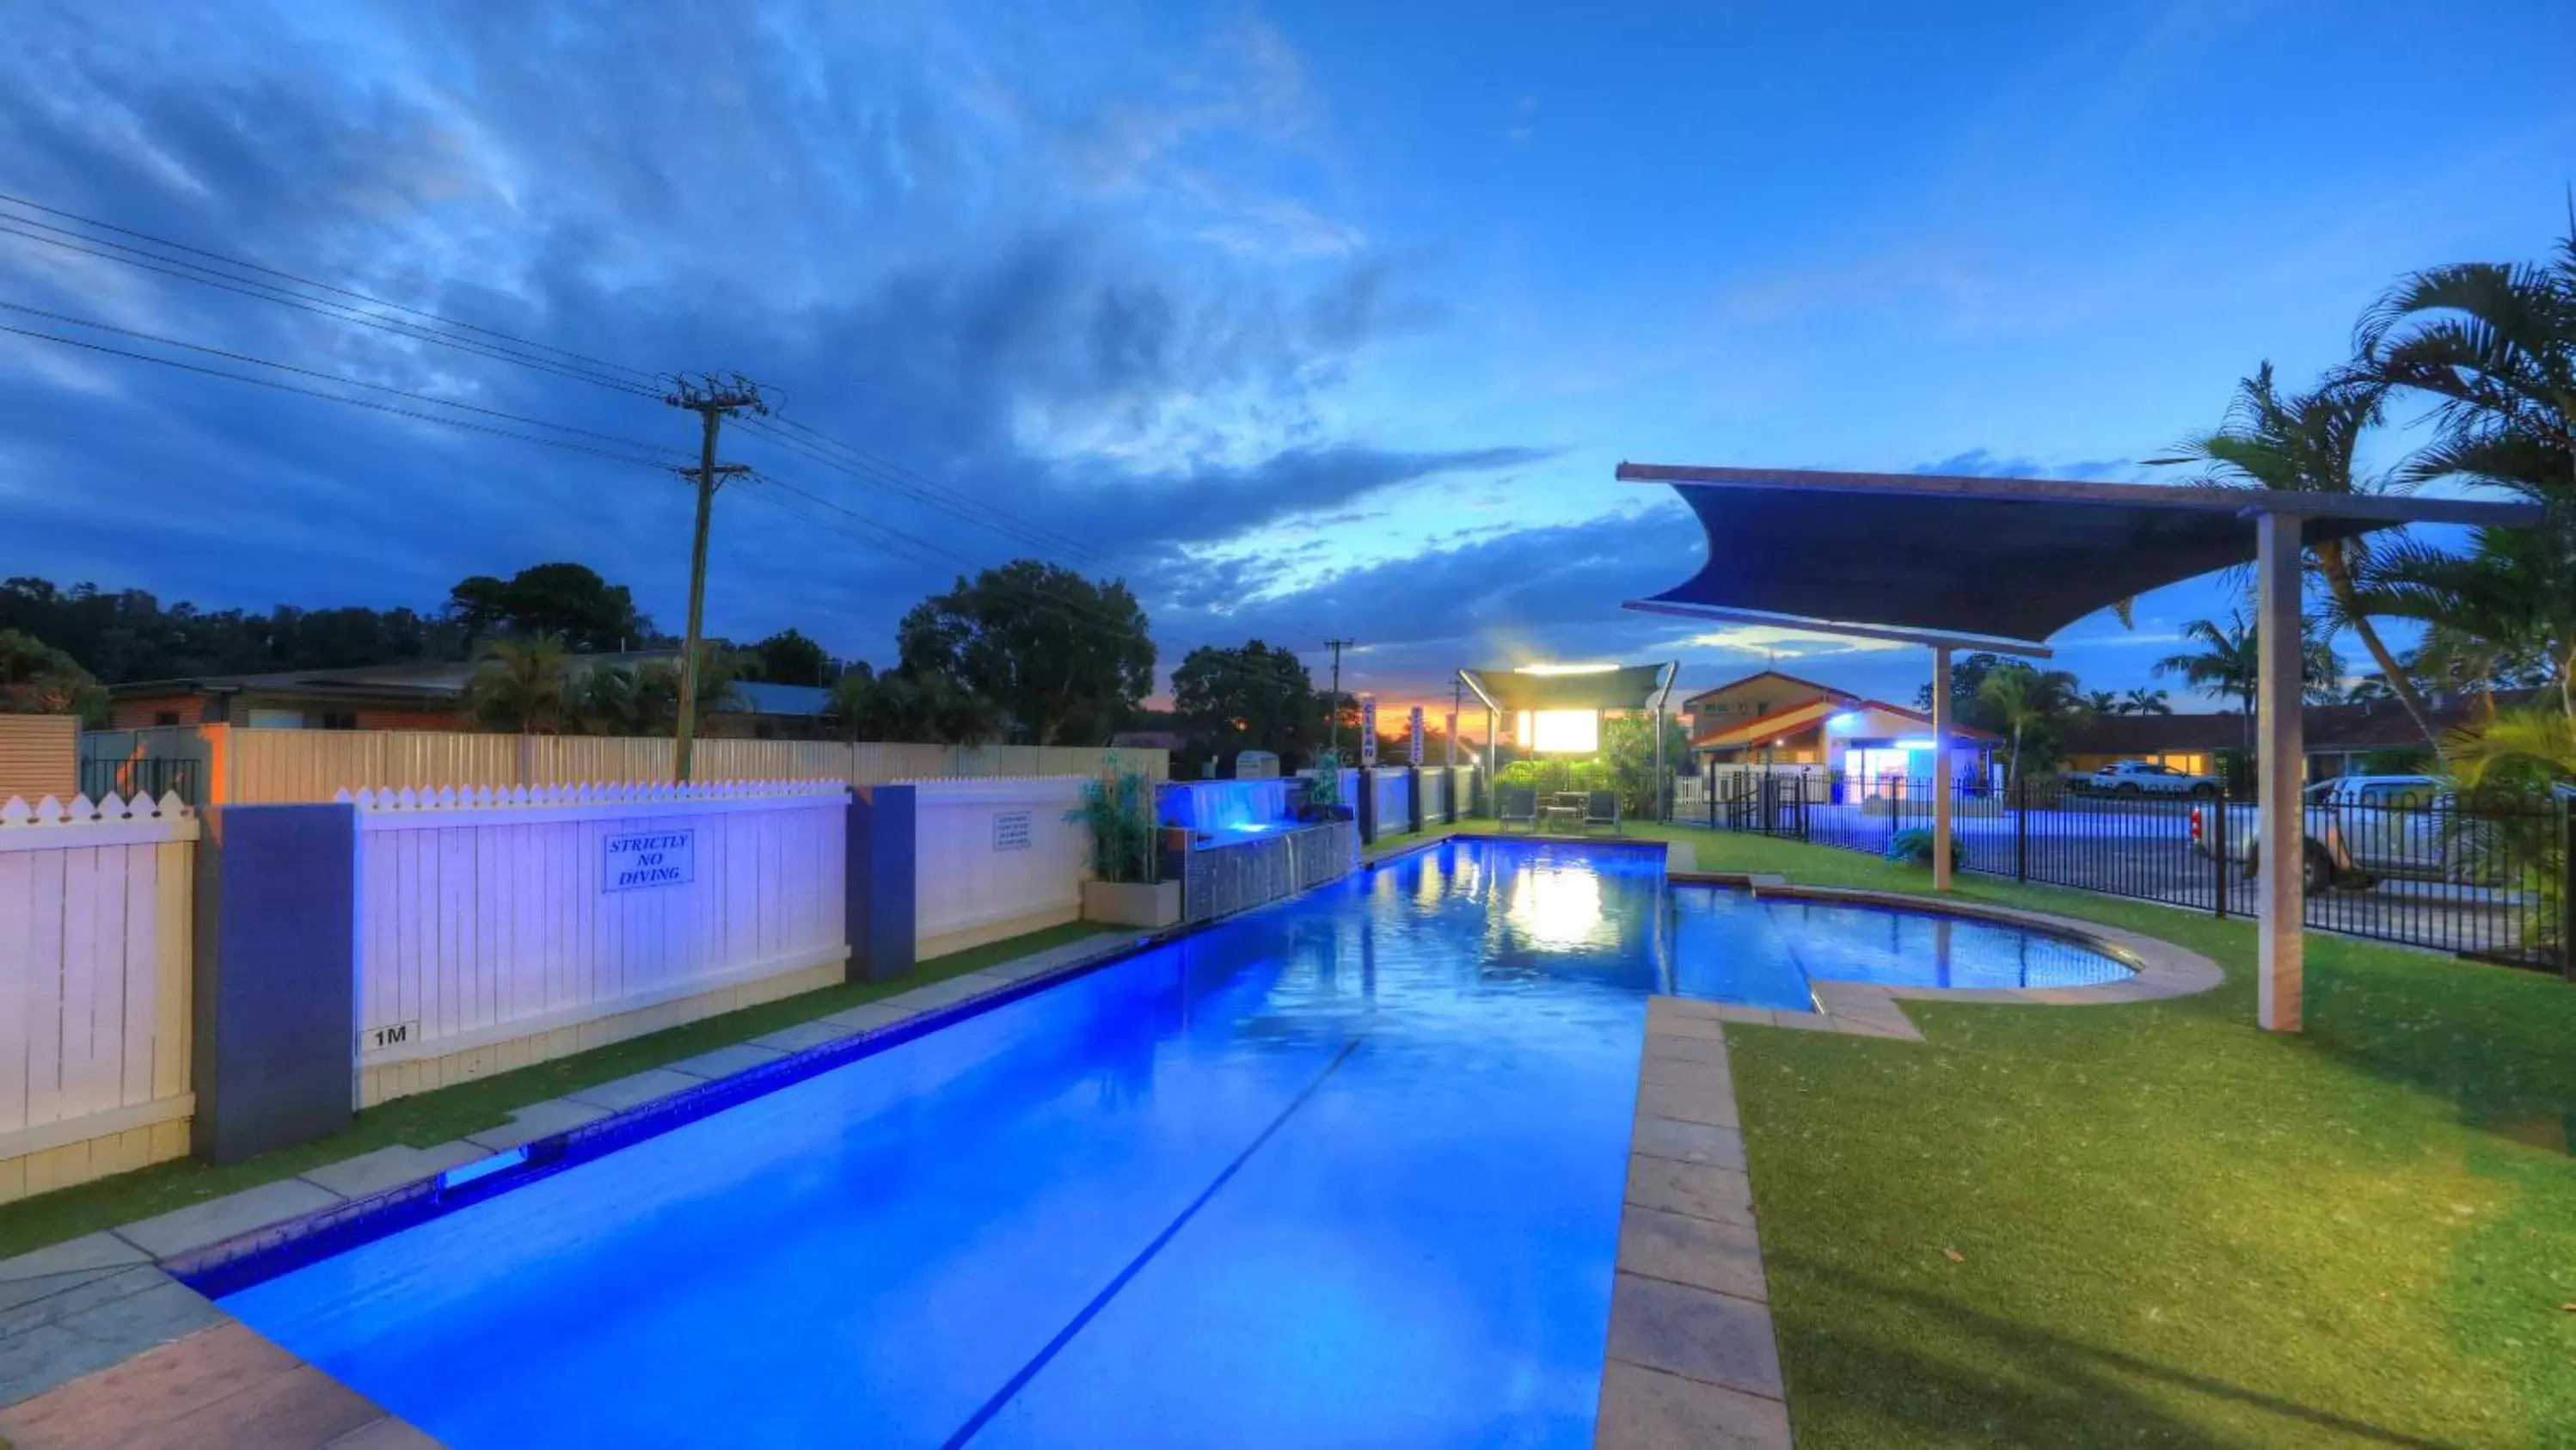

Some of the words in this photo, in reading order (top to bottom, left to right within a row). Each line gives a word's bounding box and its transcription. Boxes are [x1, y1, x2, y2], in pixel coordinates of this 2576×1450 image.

[609, 834, 688, 853] STRICTLY
[637, 853, 663, 866] NO
[619, 867, 679, 885] DIVING
[375, 1025, 406, 1046] 1M
